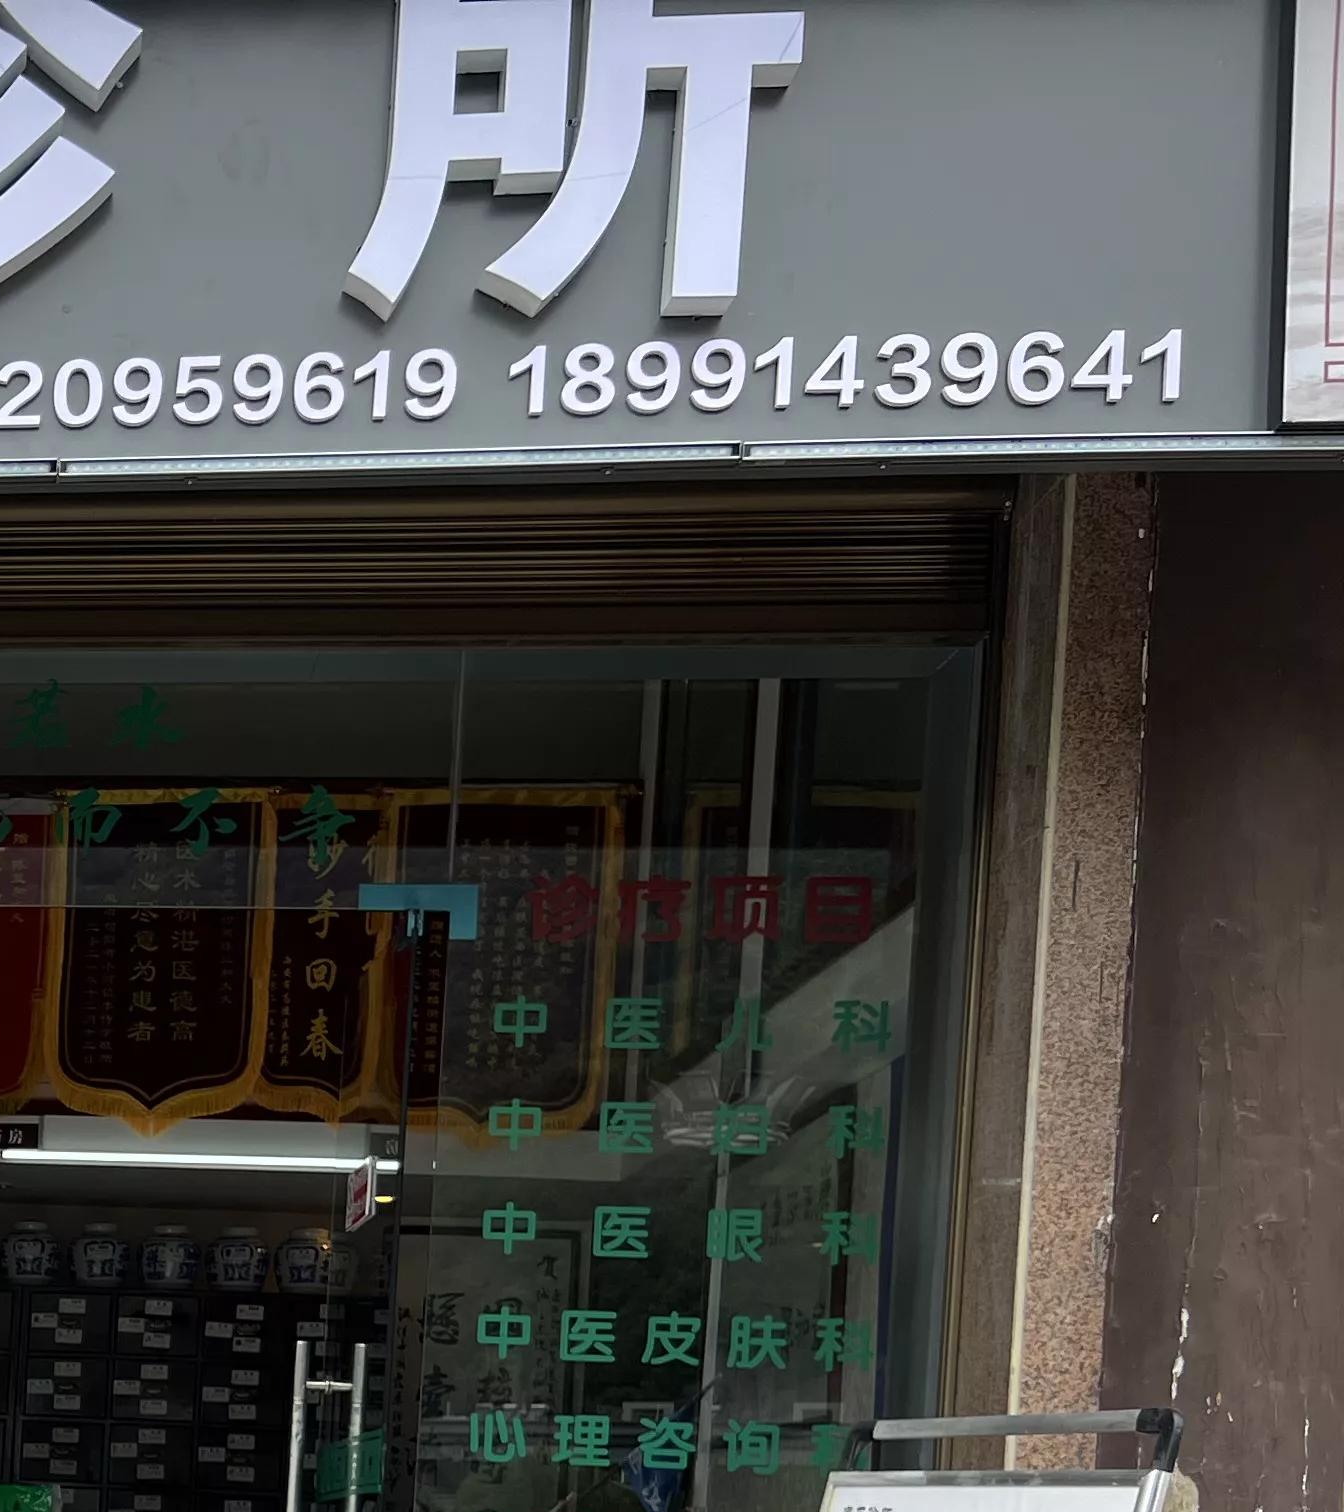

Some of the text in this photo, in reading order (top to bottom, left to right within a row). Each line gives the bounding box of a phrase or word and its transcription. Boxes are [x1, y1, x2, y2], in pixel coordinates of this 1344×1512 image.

[506, 326, 1187, 416] 18991439641
[526, 873, 872, 943] 诊疗项目
[493, 994, 892, 1052] 中医儿科
[488, 1096, 885, 1159] 中医妇科
[482, 1201, 880, 1266] 中医眼科
[476, 1306, 875, 1373] 中医皮肤科
